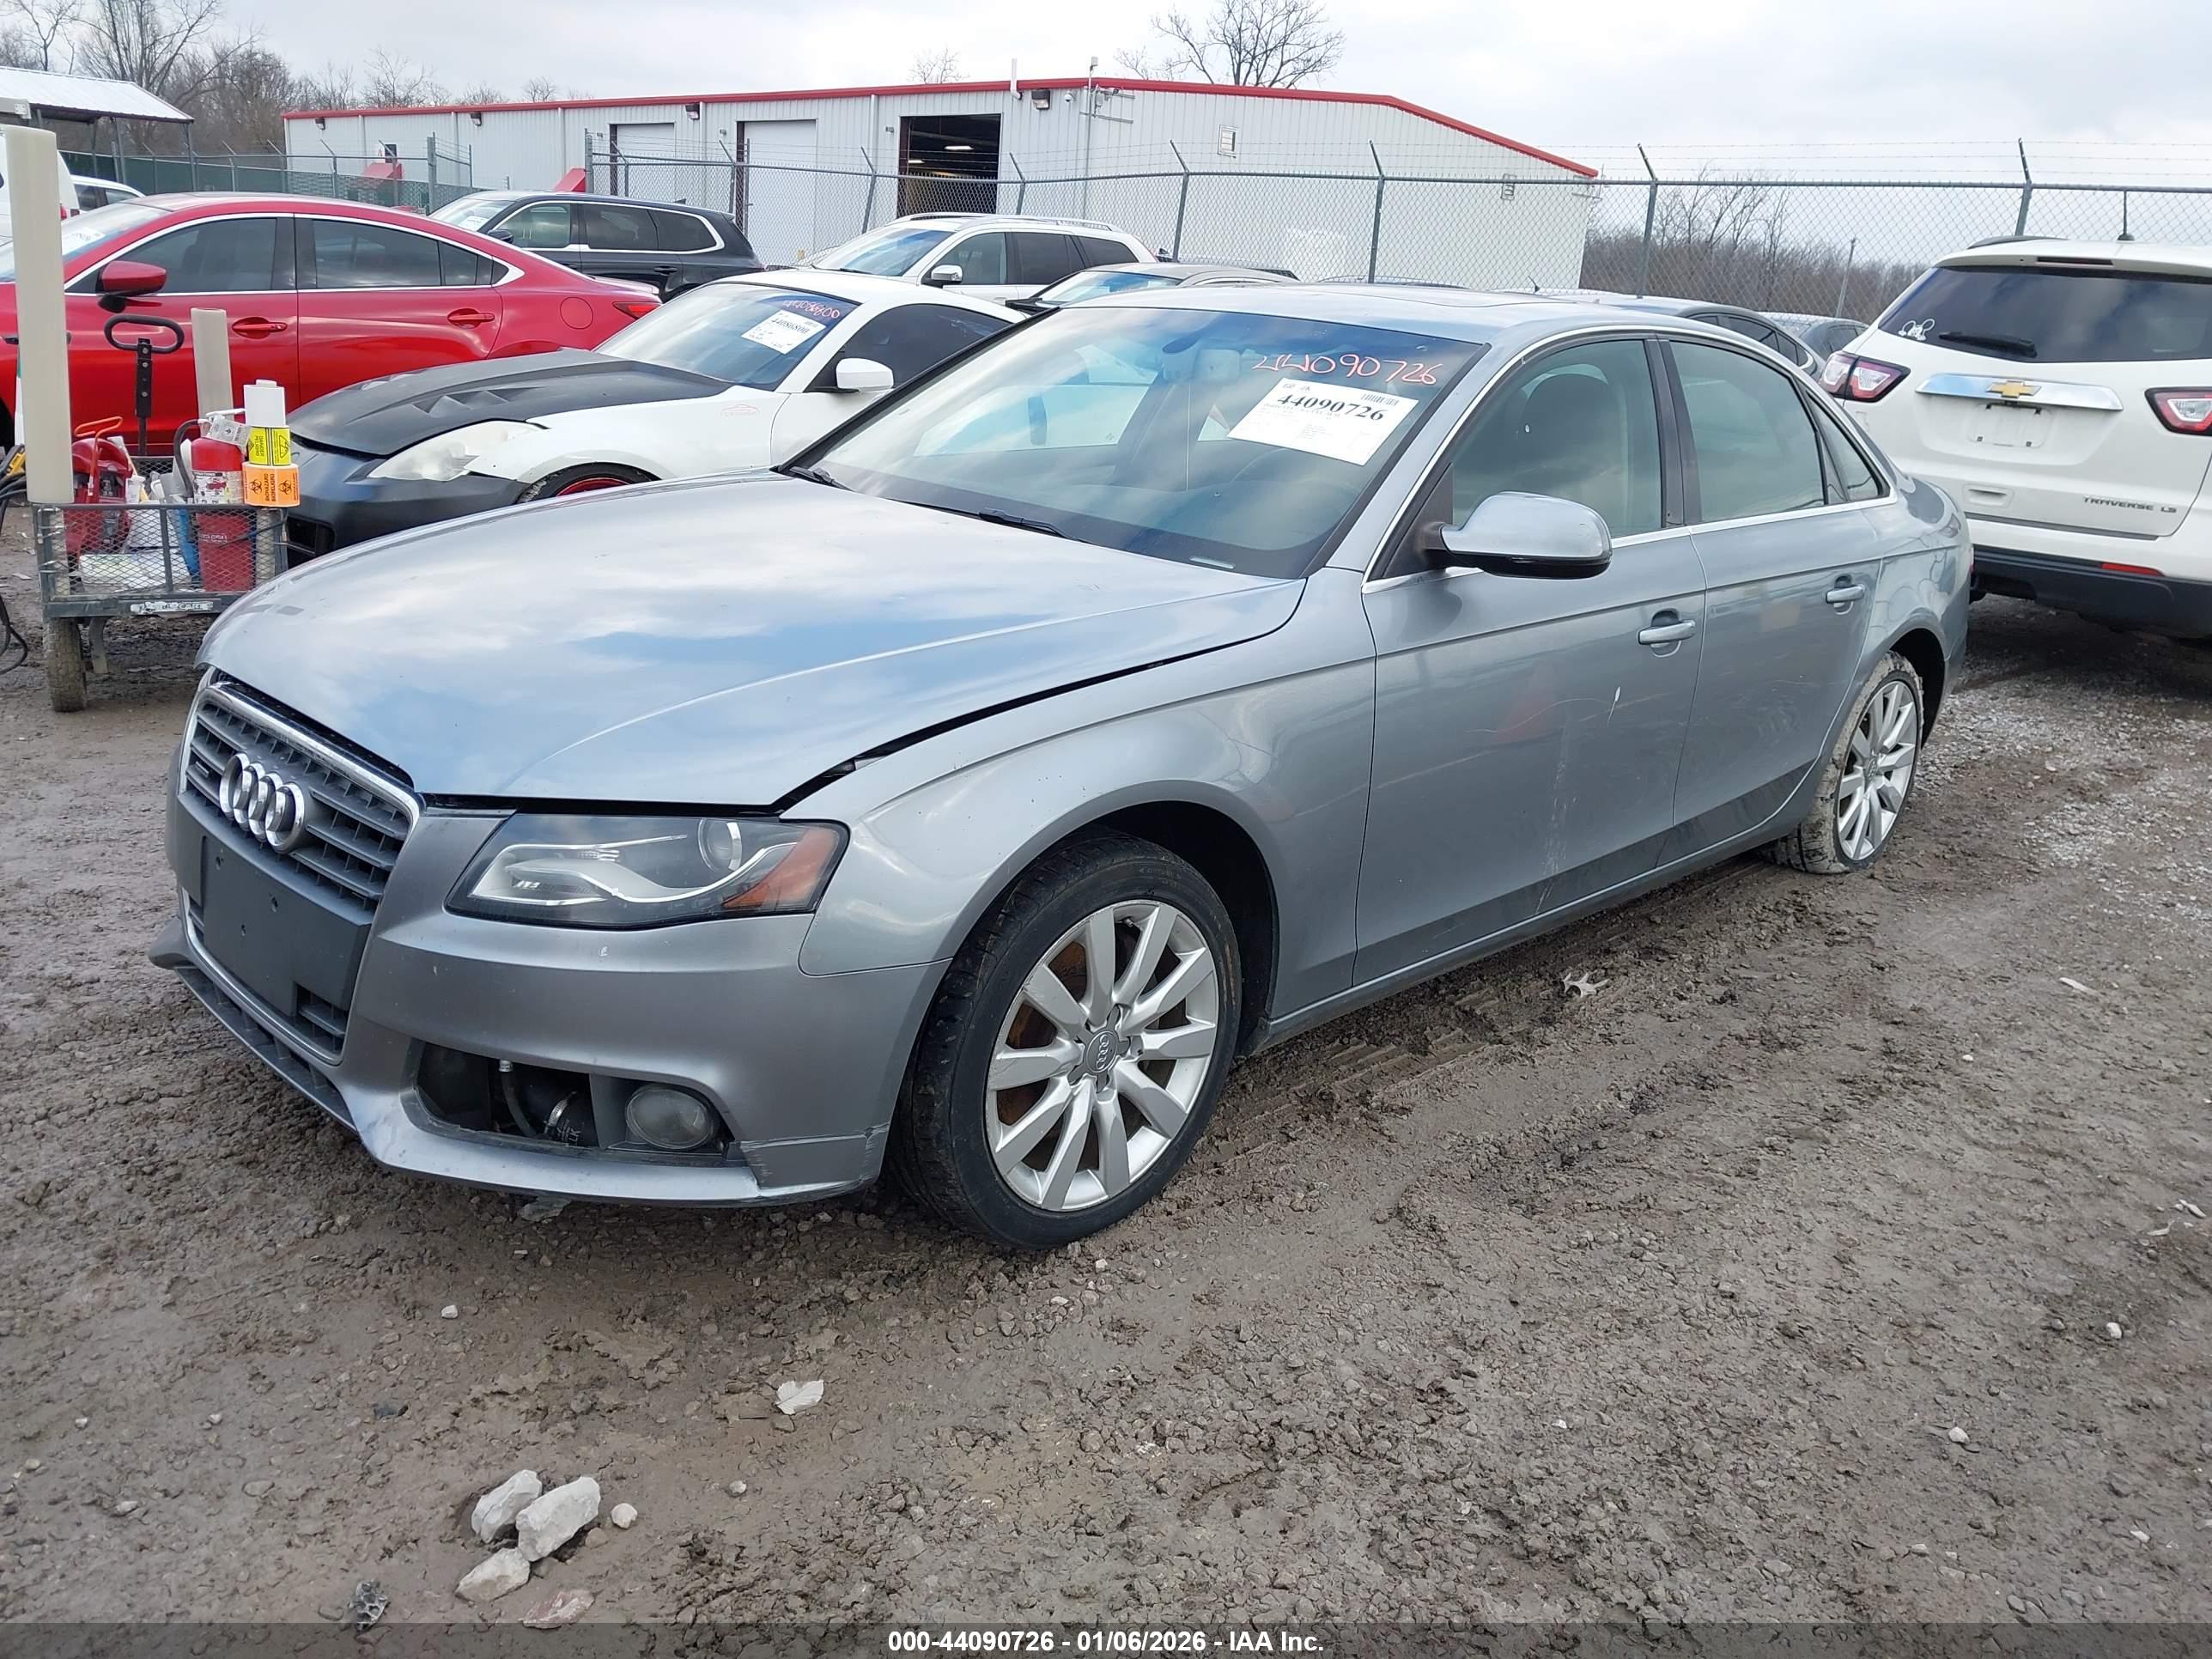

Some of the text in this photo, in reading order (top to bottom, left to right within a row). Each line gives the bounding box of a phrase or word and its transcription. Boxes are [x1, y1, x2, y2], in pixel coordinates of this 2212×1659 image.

[1252, 354, 1443, 385] 44090726
[1277, 394, 1389, 421] 44090726
[2084, 497, 2154, 510] TRAVERSE
